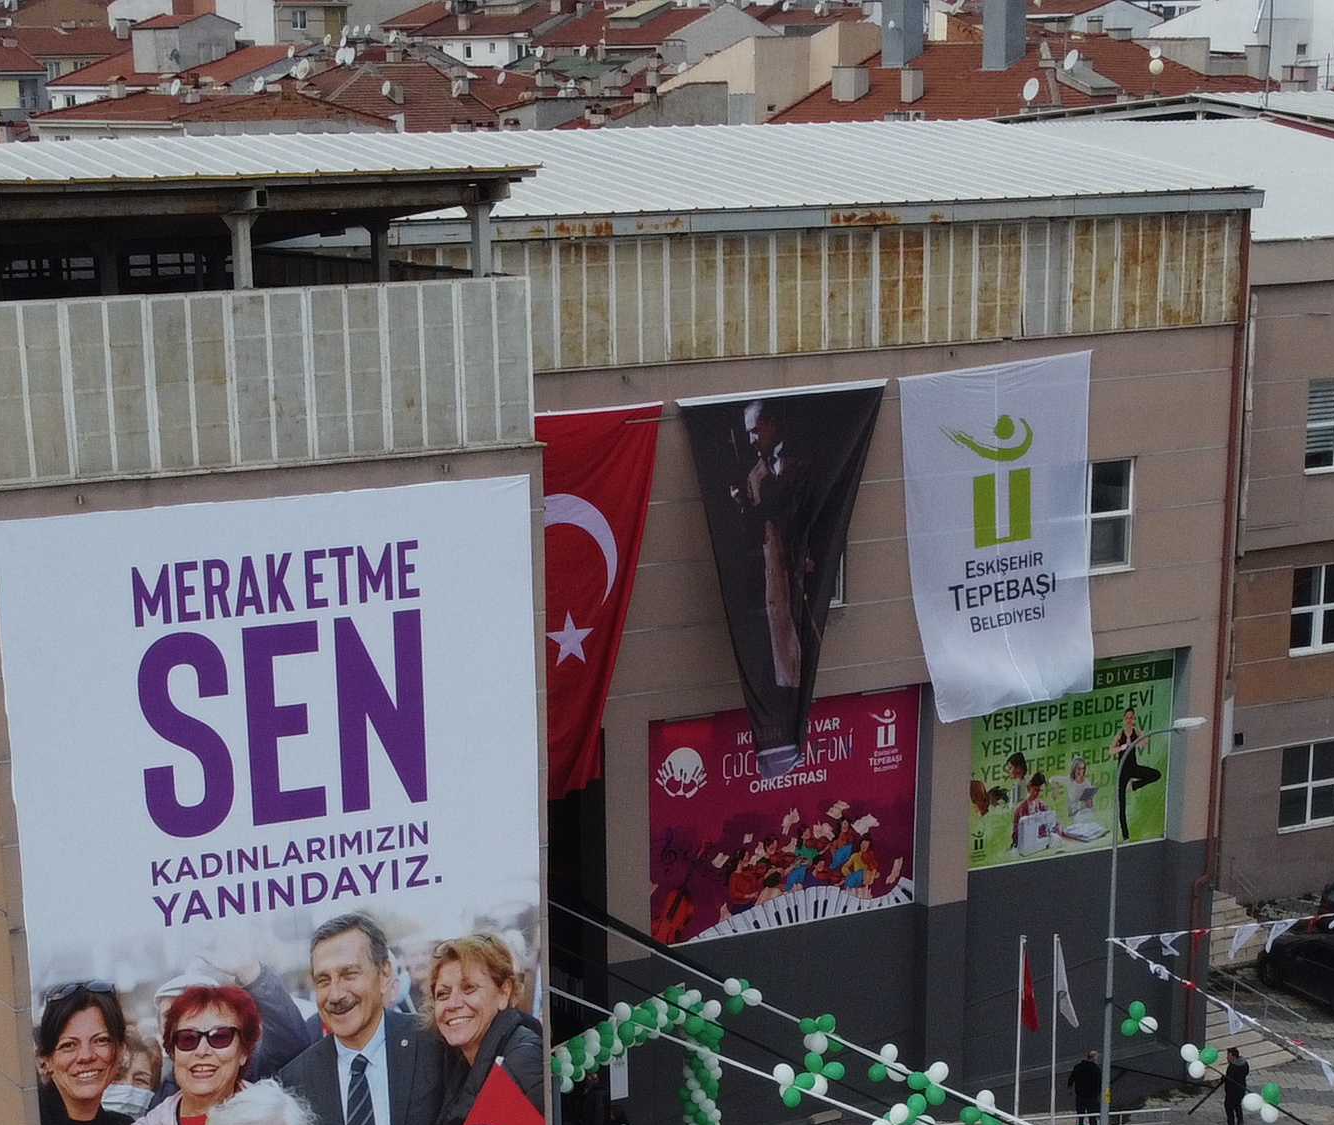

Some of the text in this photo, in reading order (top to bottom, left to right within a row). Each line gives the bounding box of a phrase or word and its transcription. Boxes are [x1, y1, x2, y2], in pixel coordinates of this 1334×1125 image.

[965, 552, 1044, 580] ESKİŞEHİR
[131, 539, 421, 628] MERAK ETME
[948, 572, 1057, 612] TEPEBAŞI
[969, 605, 1046, 633] BELEDİYESİ
[1096, 663, 1156, 685] EDİYESİ
[137, 608, 429, 838] SEN
[814, 717, 841, 733] VAR
[982, 685, 1154, 732] YEŞİLTEPE BELDE EVİ
[981, 728, 1067, 758] YEŞİLTEPE
[723, 750, 761, 786] ÇOC
[749, 769, 828, 794] ORKESTRASI
[981, 753, 1066, 783] YEŞTEPE
[151, 820, 430, 887] KADINLARIMIZIN
[151, 854, 443, 928] YANINDAYIZ.
